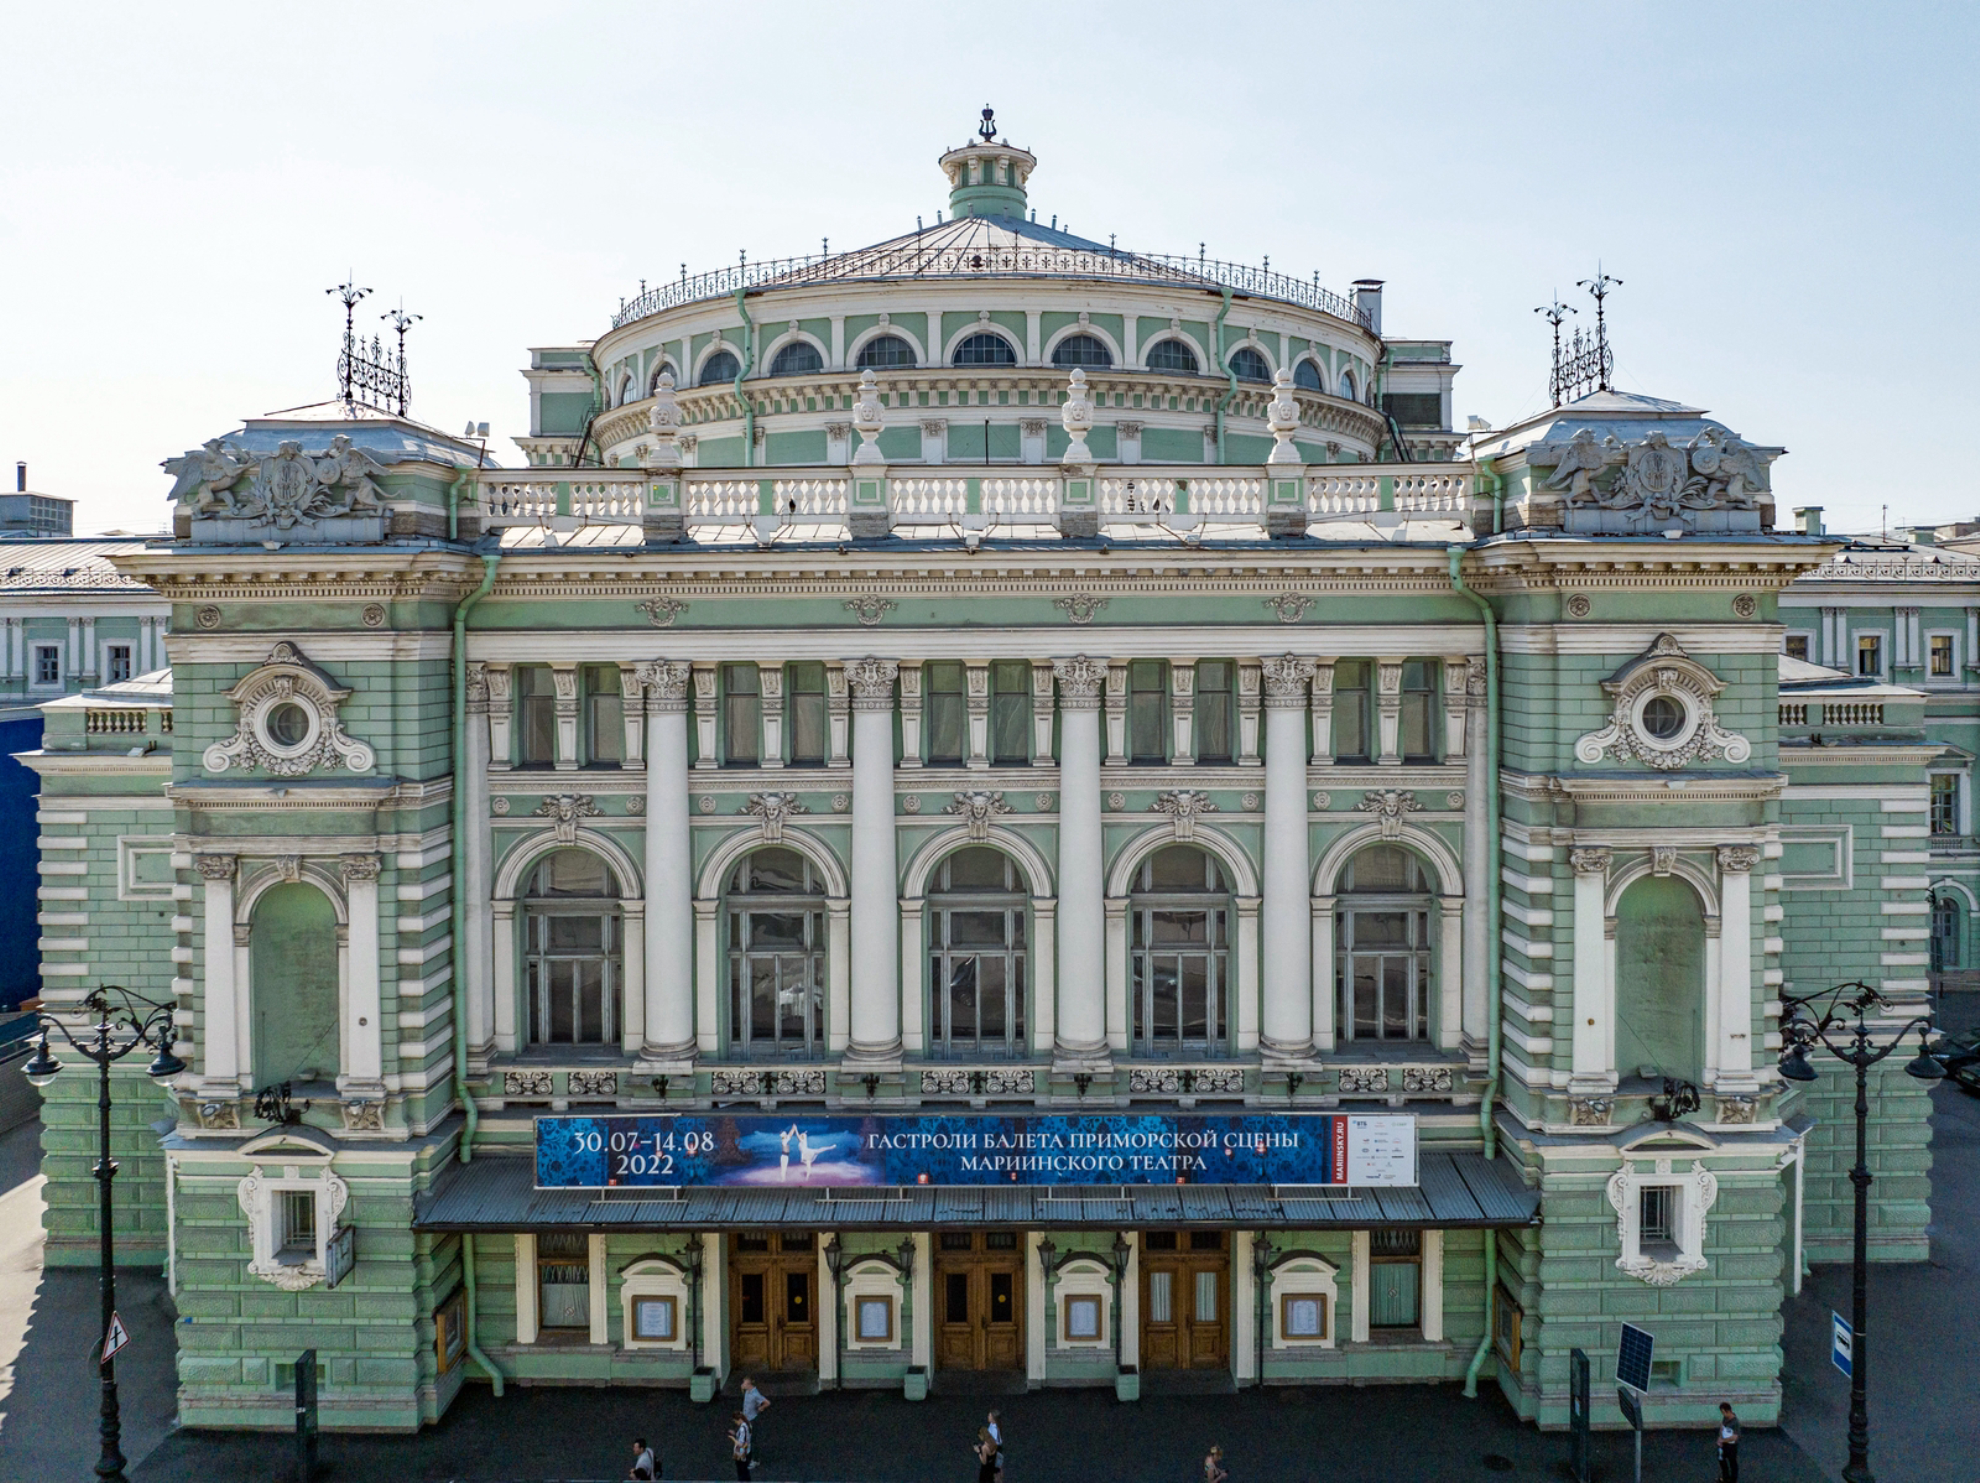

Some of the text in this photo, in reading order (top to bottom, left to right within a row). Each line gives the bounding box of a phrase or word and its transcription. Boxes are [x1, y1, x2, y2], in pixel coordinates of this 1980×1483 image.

[868, 1130, 1299, 1150] ГАСТРОЛИ БАЛЕТА ПРИМОРСКОЙ СЦЕНЫ
[1335, 1121, 1345, 1180] MARIINSKY.RU
[615, 1154, 673, 1174] 2022
[960, 1155, 1207, 1171] МАРИИНСКОГО ТЕАТРА
